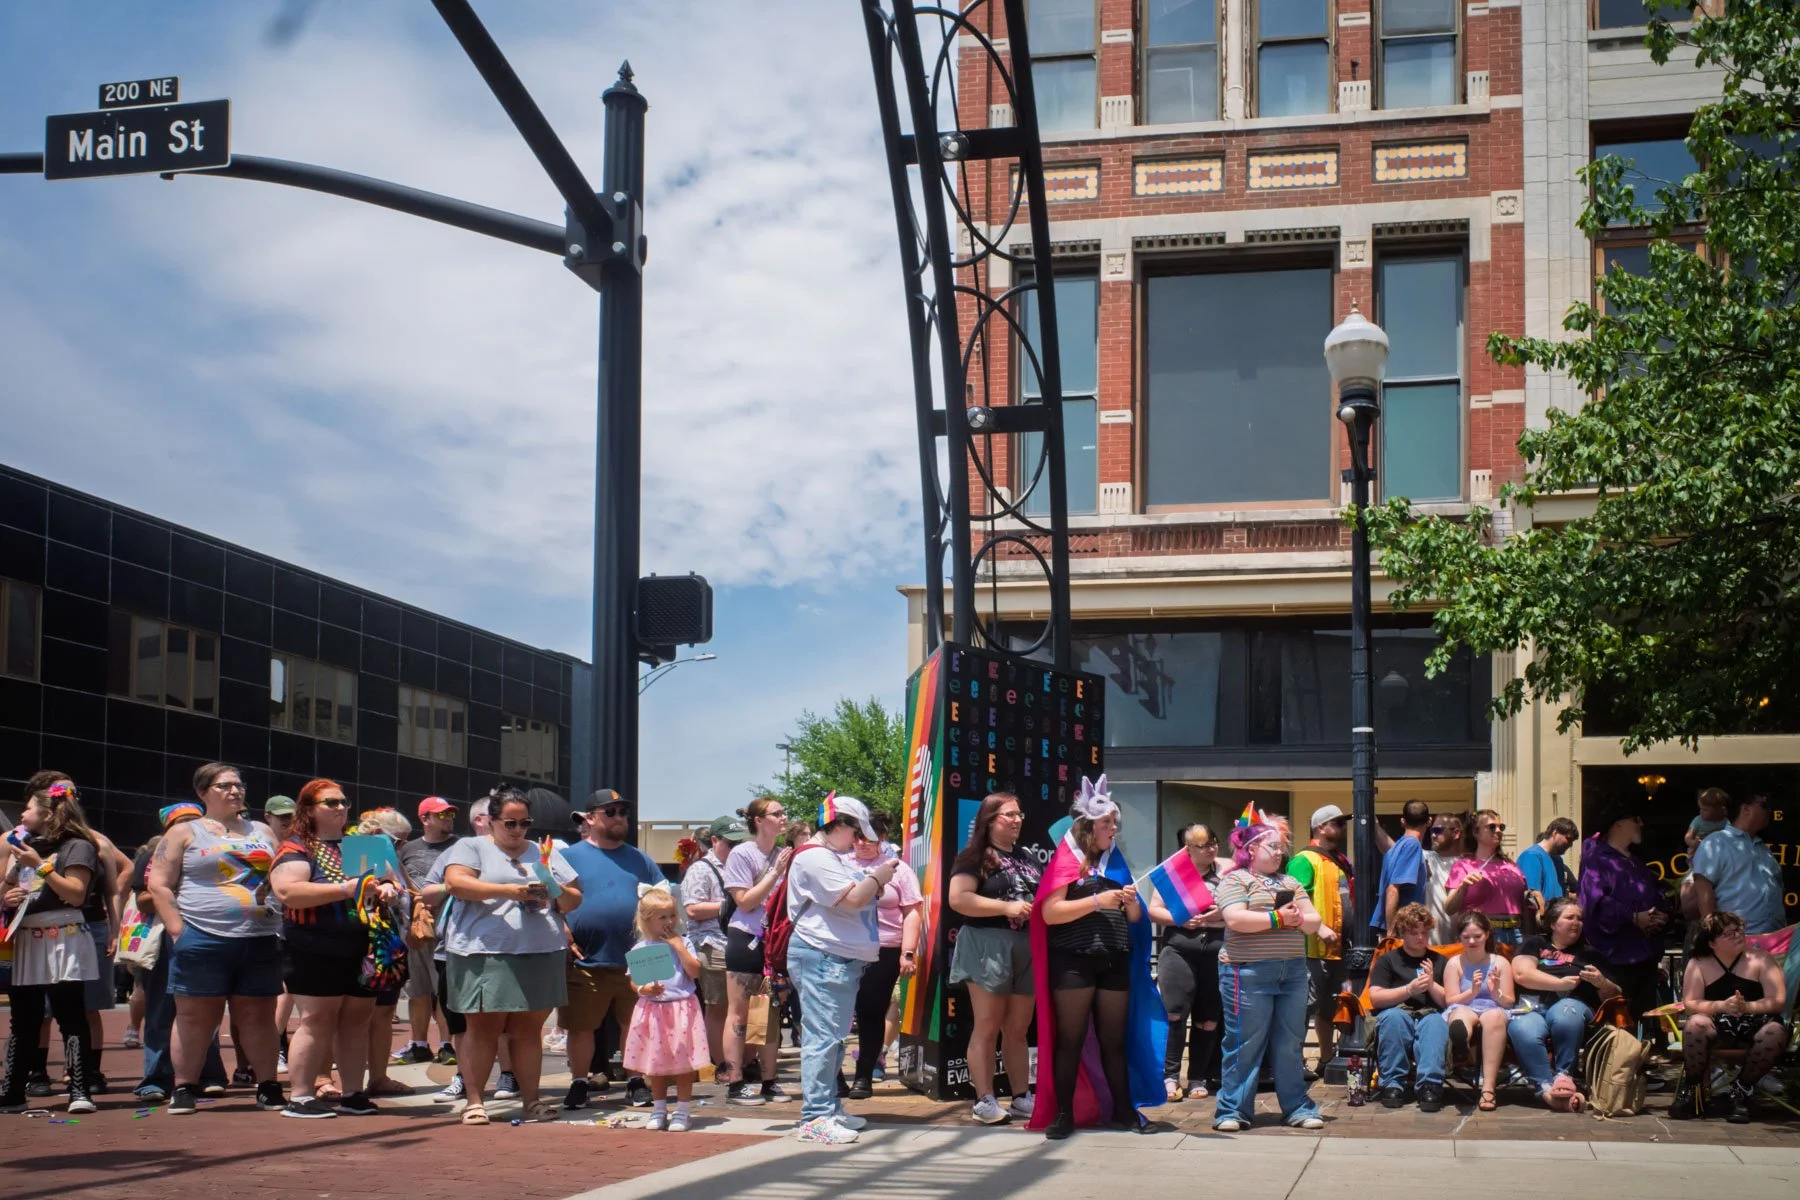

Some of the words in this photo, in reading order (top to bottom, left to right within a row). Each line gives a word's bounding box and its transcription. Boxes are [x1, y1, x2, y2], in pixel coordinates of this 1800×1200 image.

[105, 82, 140, 102] 200
[149, 78, 172, 97] NE
[69, 126, 147, 162] Main
[168, 119, 204, 154] St
[1006, 689, 1017, 704] e
